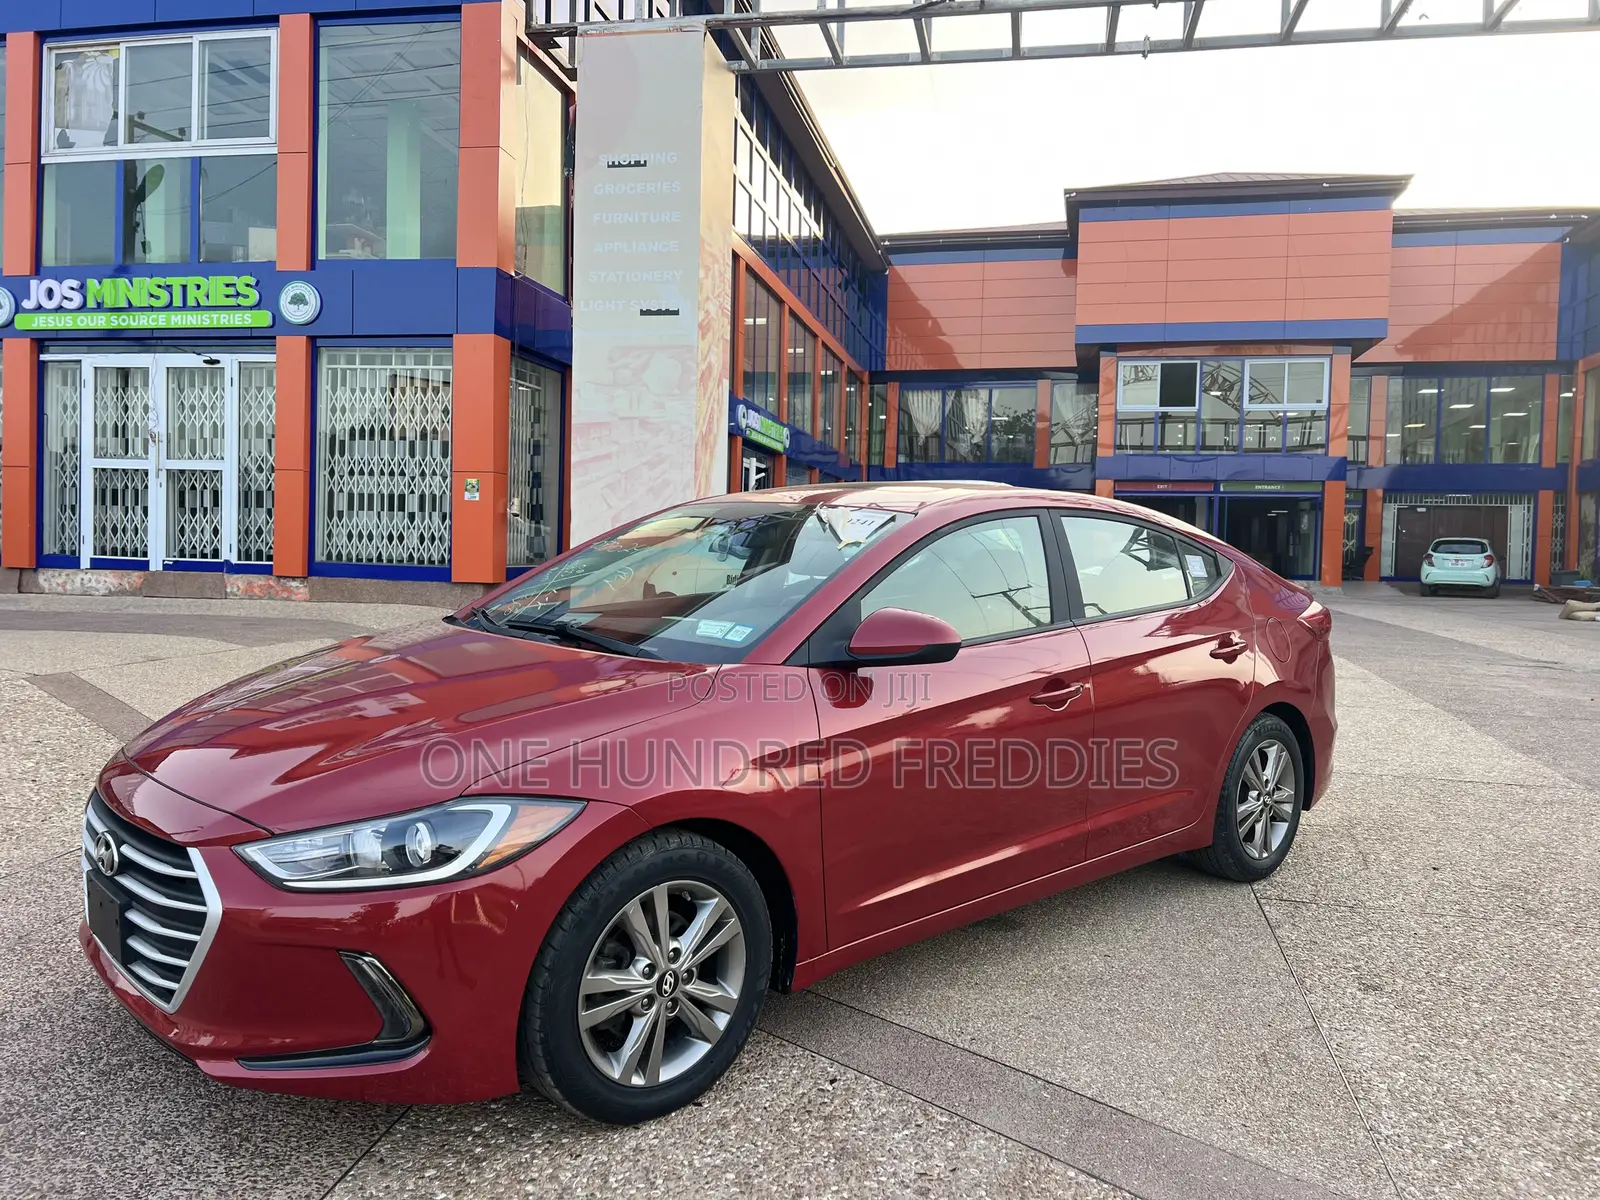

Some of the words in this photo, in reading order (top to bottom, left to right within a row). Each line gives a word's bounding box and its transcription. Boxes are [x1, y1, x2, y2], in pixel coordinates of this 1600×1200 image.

[598, 152, 678, 166] SHOPPING
[593, 180, 681, 195] GROCERIES
[592, 211, 682, 225] FURNITURE
[593, 240, 680, 253] APPLIANCE
[588, 269, 684, 283] STATIONERY
[21, 278, 84, 310] JOS
[86, 275, 260, 308] MINISTRIES
[578, 299, 628, 313] LIGHT
[31, 315, 74, 327] JESUS
[77, 315, 107, 327] OUR
[110, 314, 167, 327] SOURCE
[170, 313, 252, 325] MINISTRIES
